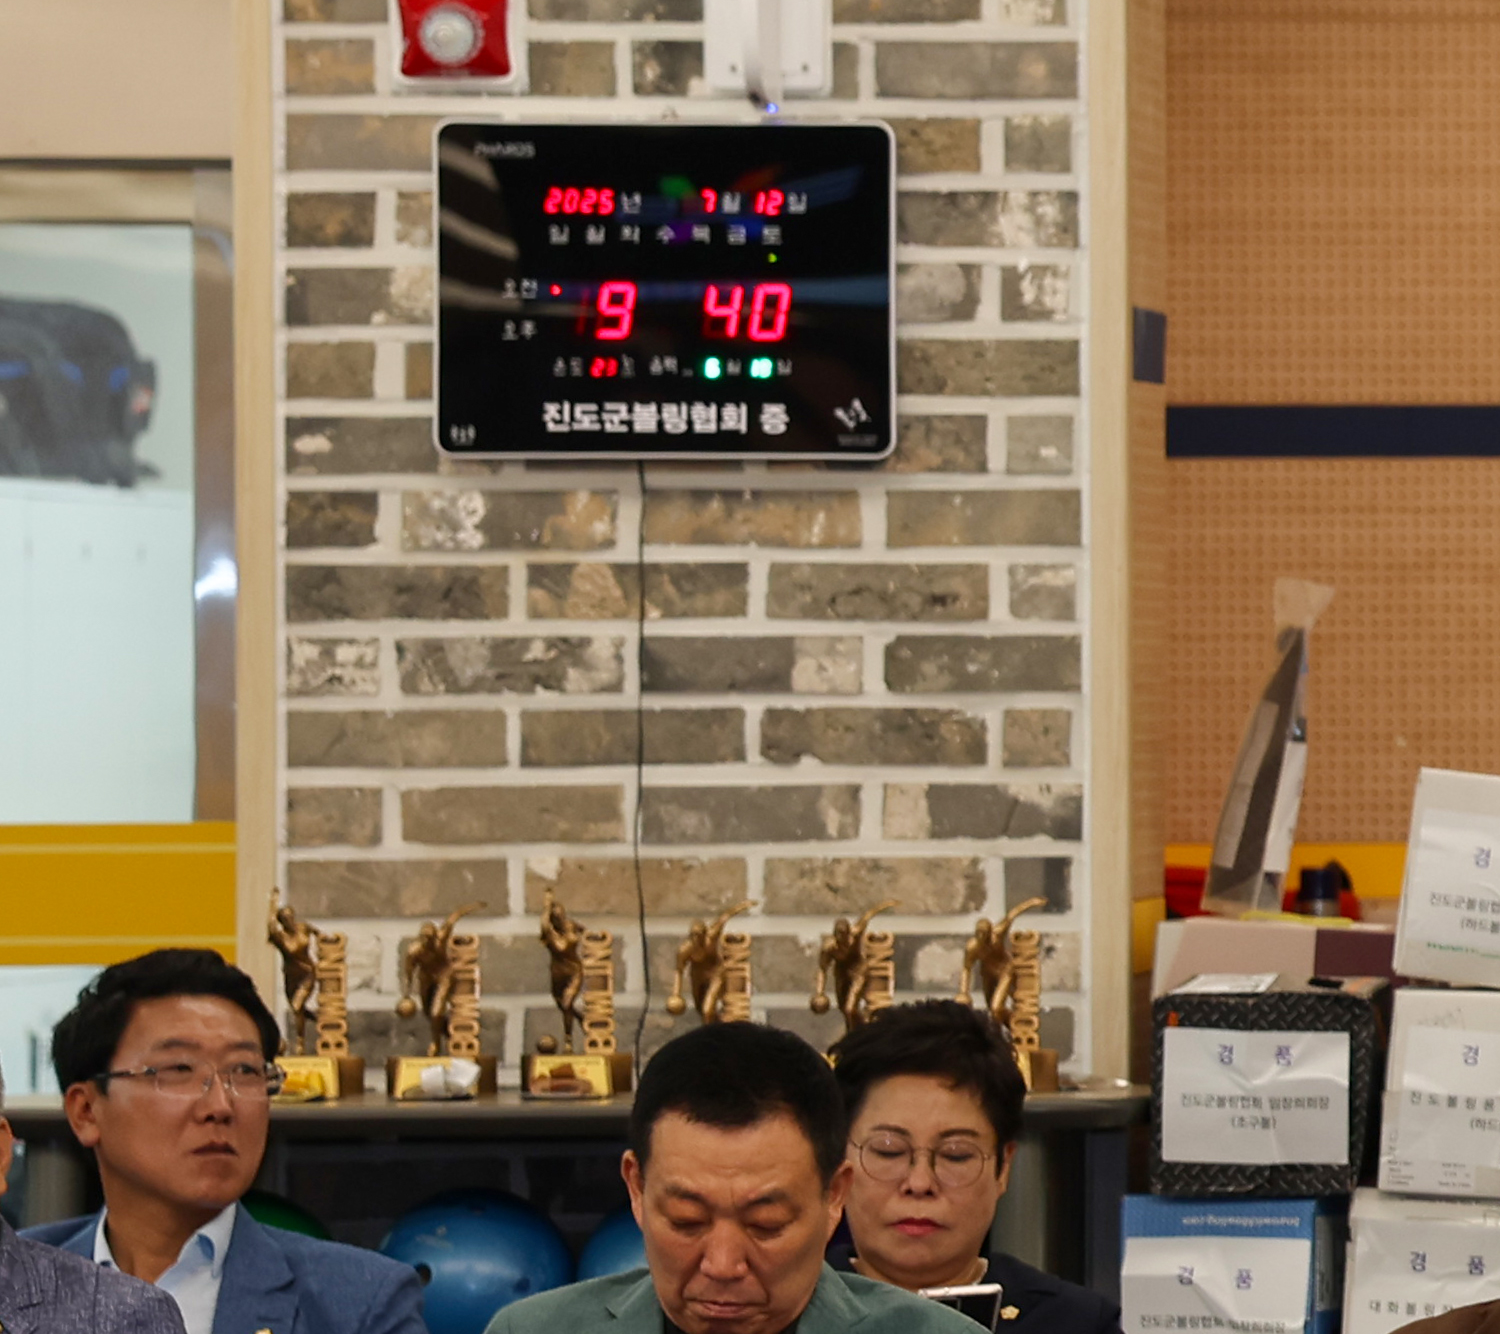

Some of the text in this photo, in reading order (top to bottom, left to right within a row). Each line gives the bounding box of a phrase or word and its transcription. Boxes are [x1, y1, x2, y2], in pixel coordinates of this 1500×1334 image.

[543, 186, 616, 216] 2025
[701, 187, 718, 214] 7
[755, 188, 785, 216] 12
[703, 282, 793, 343] 40
[542, 401, 749, 435] 진도군볼링협회
